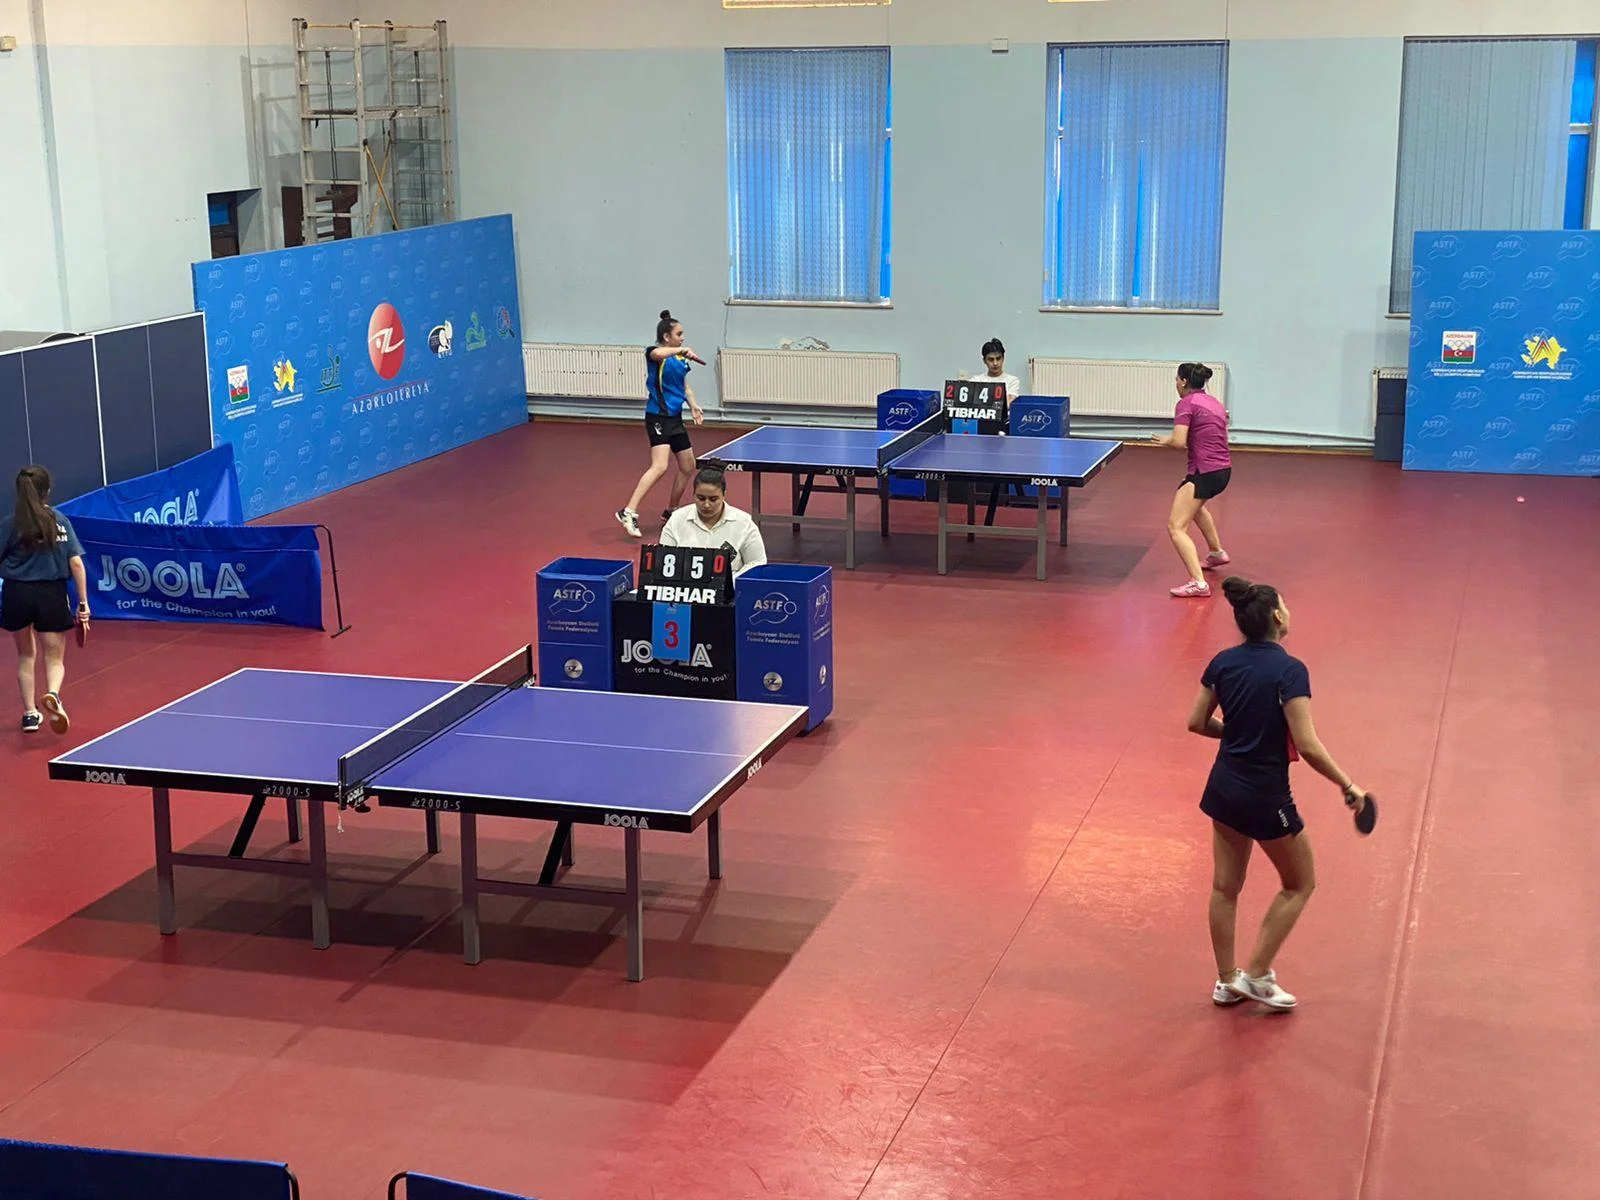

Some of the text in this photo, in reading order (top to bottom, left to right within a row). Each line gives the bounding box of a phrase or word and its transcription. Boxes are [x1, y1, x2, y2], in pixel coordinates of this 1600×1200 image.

[946, 385, 1003, 402] 2 6 4 0
[946, 407, 996, 420] TIBHAR
[1030, 478, 1058, 486] JOOLA
[645, 552, 724, 579] 1 8 5 0
[553, 589, 582, 600] ASTF
[644, 585, 716, 604] TIBHAR
[116, 598, 276, 618] for the Champion in you!
[754, 600, 784, 610] ASTF
[664, 621, 679, 649] 3
[621, 639, 713, 668] JOA
[663, 668, 700, 682] Champion
[85, 770, 126, 784] JOOLA
[604, 814, 649, 828] JOOLA
